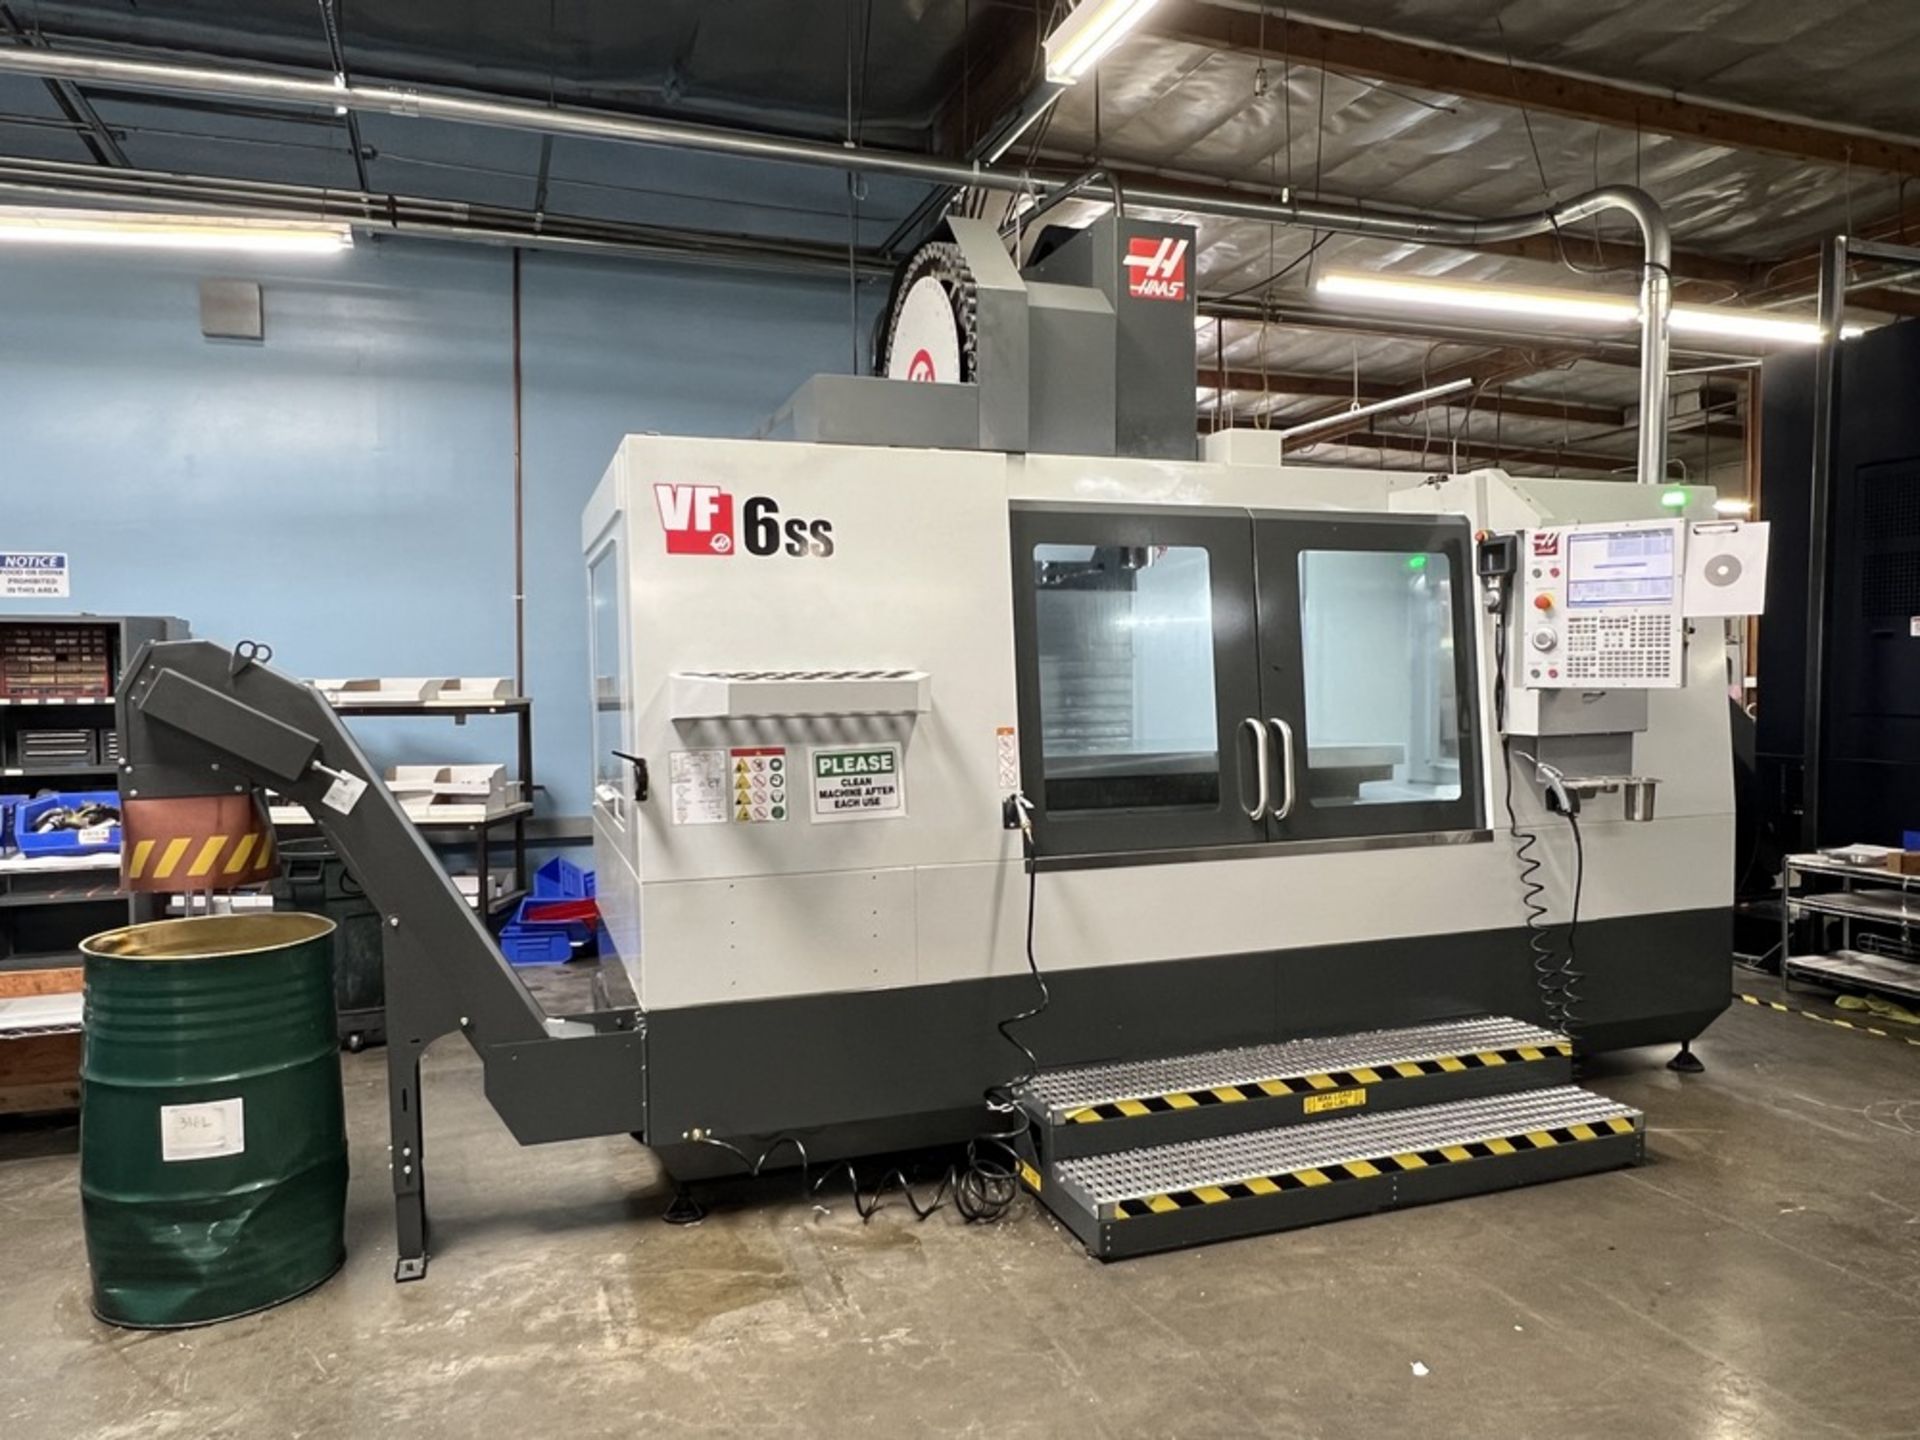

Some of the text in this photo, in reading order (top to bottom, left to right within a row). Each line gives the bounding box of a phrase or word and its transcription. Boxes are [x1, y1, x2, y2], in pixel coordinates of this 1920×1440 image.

[1129, 279, 1185, 297] HAAS
[654, 484, 721, 532] VF
[5, 556, 58, 568] NOTICE
[819, 754, 893, 774] PLEASE
[840, 777, 873, 788] CLEAN
[819, 785, 896, 800] MACHINE AFTER
[834, 797, 881, 809] EACH USE
